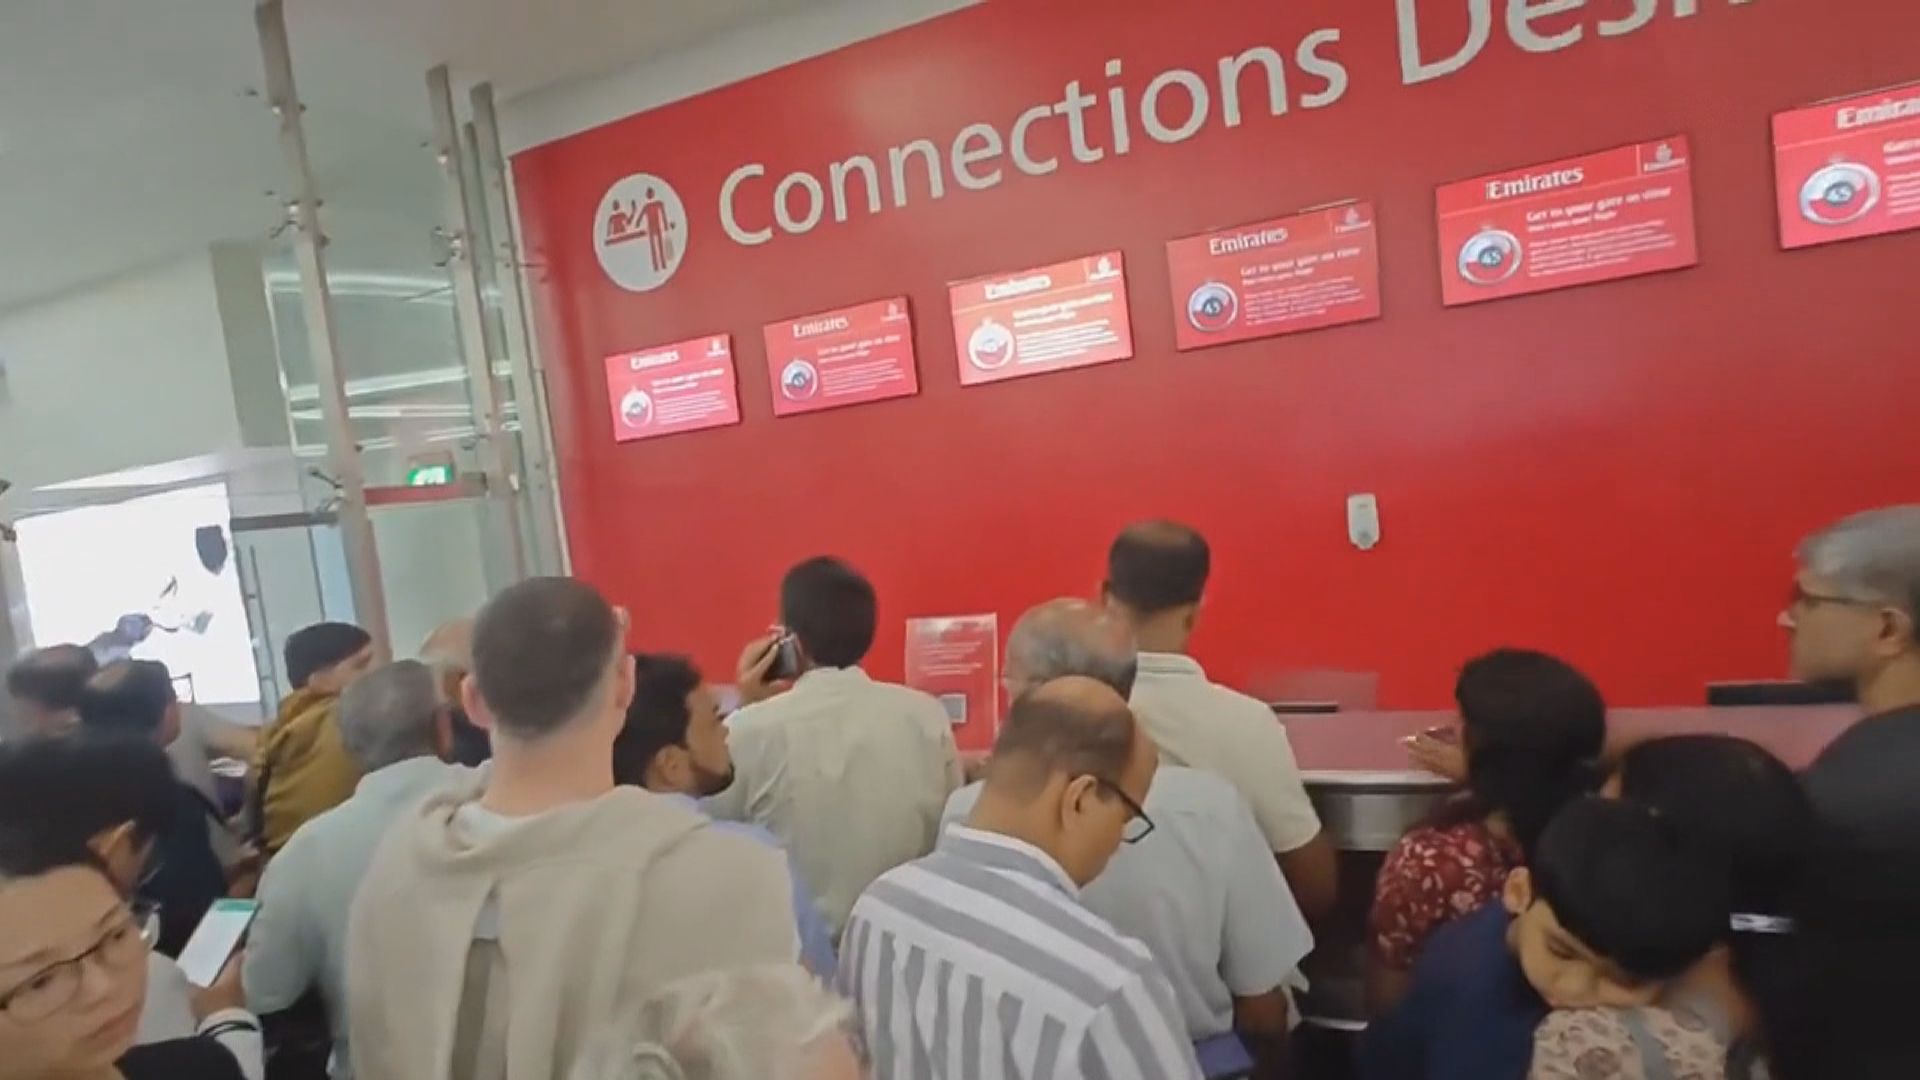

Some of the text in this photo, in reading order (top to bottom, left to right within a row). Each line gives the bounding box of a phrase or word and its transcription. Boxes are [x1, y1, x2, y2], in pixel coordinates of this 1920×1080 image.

[719, 27, 1349, 246] Connections
[1487, 167, 1584, 200] Emirates
[1208, 227, 1288, 256] Emirates
